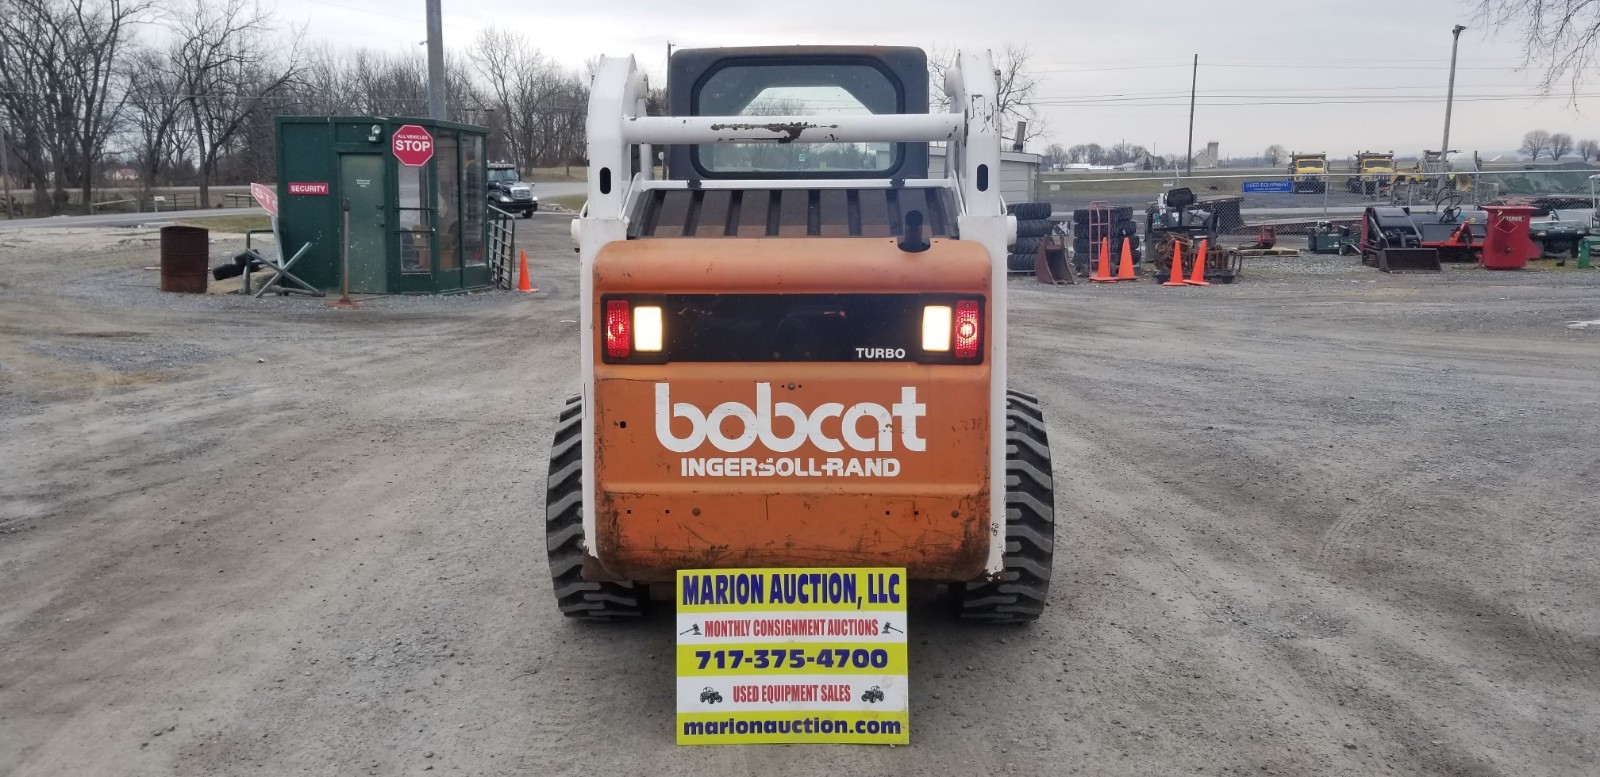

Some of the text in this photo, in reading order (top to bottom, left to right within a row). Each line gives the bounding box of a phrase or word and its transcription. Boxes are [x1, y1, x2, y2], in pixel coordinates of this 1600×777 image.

[395, 140, 430, 151] STOP
[254, 187, 278, 211] STO
[290, 185, 326, 193] SECURITY
[856, 347, 906, 359] TURBO
[655, 382, 927, 453] bobcat
[682, 572, 900, 610] MARION AUCTION, LLC
[704, 618, 879, 638] MONTHLY CONSIGNMENT AUCTIONS
[695, 648, 889, 670] 717-375-4700
[732, 684, 851, 704] USED EQUIPMENT SALES
[683, 717, 901, 736] marionauction.com
